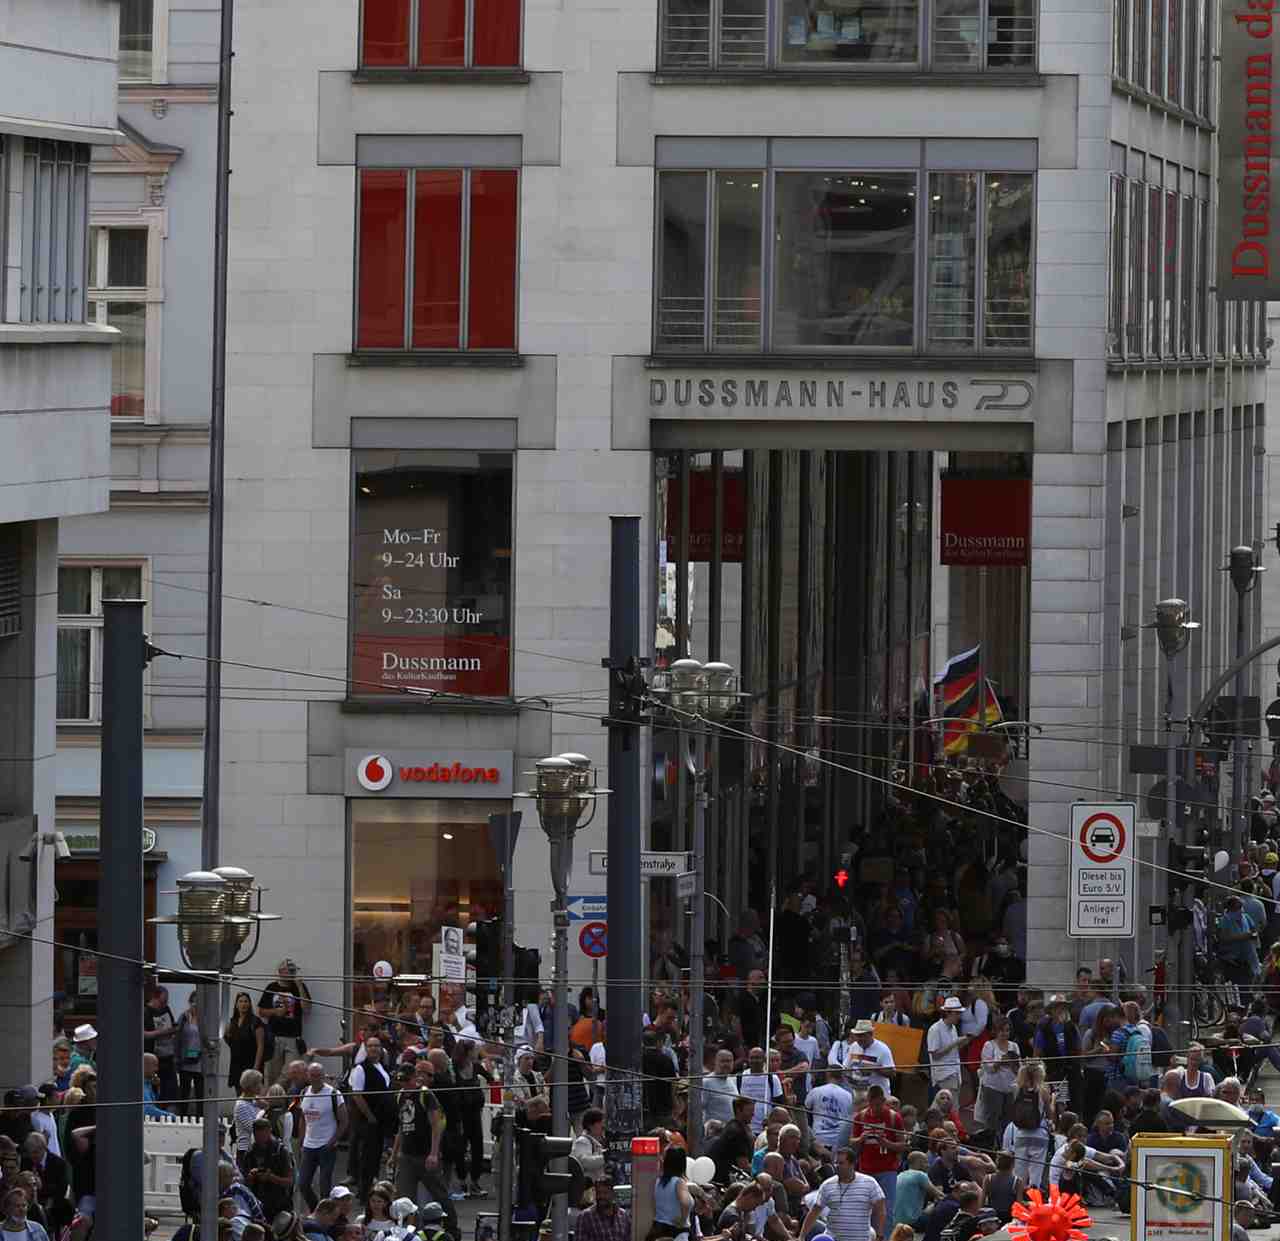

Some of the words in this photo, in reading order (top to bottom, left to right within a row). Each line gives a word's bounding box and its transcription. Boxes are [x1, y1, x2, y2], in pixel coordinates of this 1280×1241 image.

[1232, 54, 1273, 280] Dussmann
[649, 379, 959, 409] DUSSMANN-HAUS
[944, 533, 1025, 549] Dussmann
[429, 552, 460, 568] Uhr
[383, 584, 402, 600] Sa
[452, 609, 483, 625] Uhr
[382, 653, 482, 671] Dussmann
[399, 761, 499, 784] vodafone
[1081, 871, 1108, 882] Diesel
[1110, 871, 1122, 882] bis
[1082, 883, 1104, 893] Euro
[1083, 903, 1120, 915] Anlieger
[1094, 914, 1110, 925] frei
